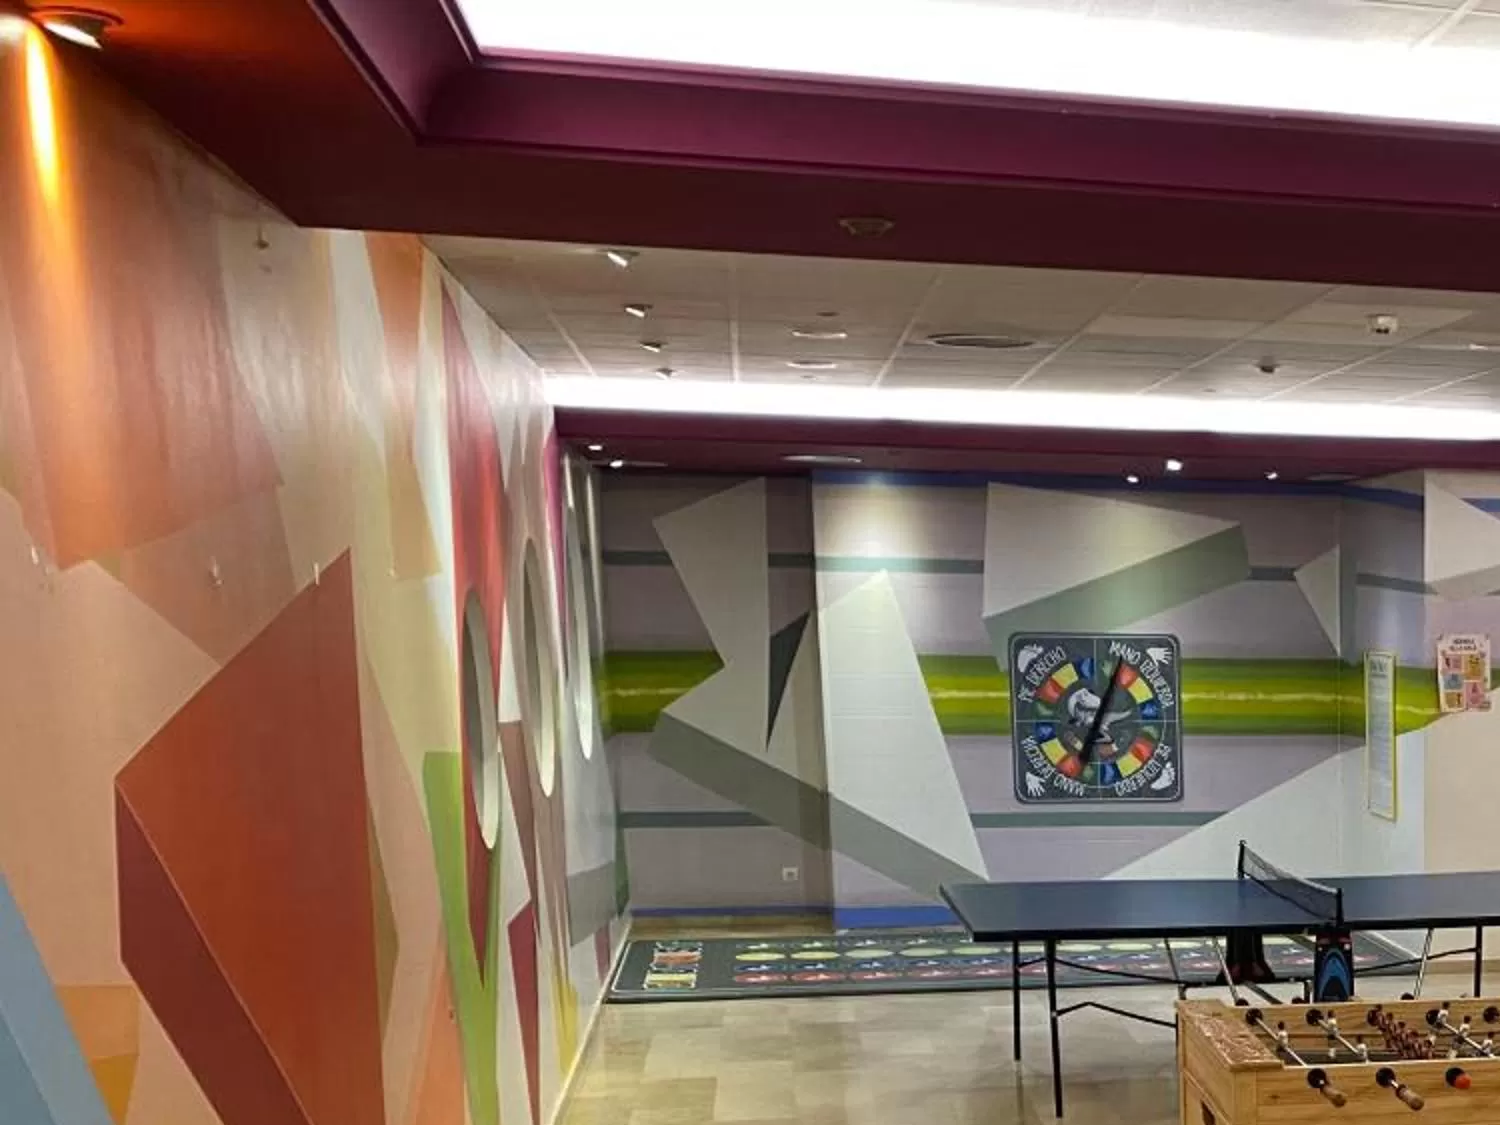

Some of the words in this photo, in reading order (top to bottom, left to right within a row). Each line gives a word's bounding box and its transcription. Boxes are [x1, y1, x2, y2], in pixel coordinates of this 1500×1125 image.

[1025, 646, 1067, 685] DERECHO
[1108, 640, 1141, 664] MANO
[1021, 735, 1055, 783] DERECHA
[1052, 775, 1087, 796] MANO
